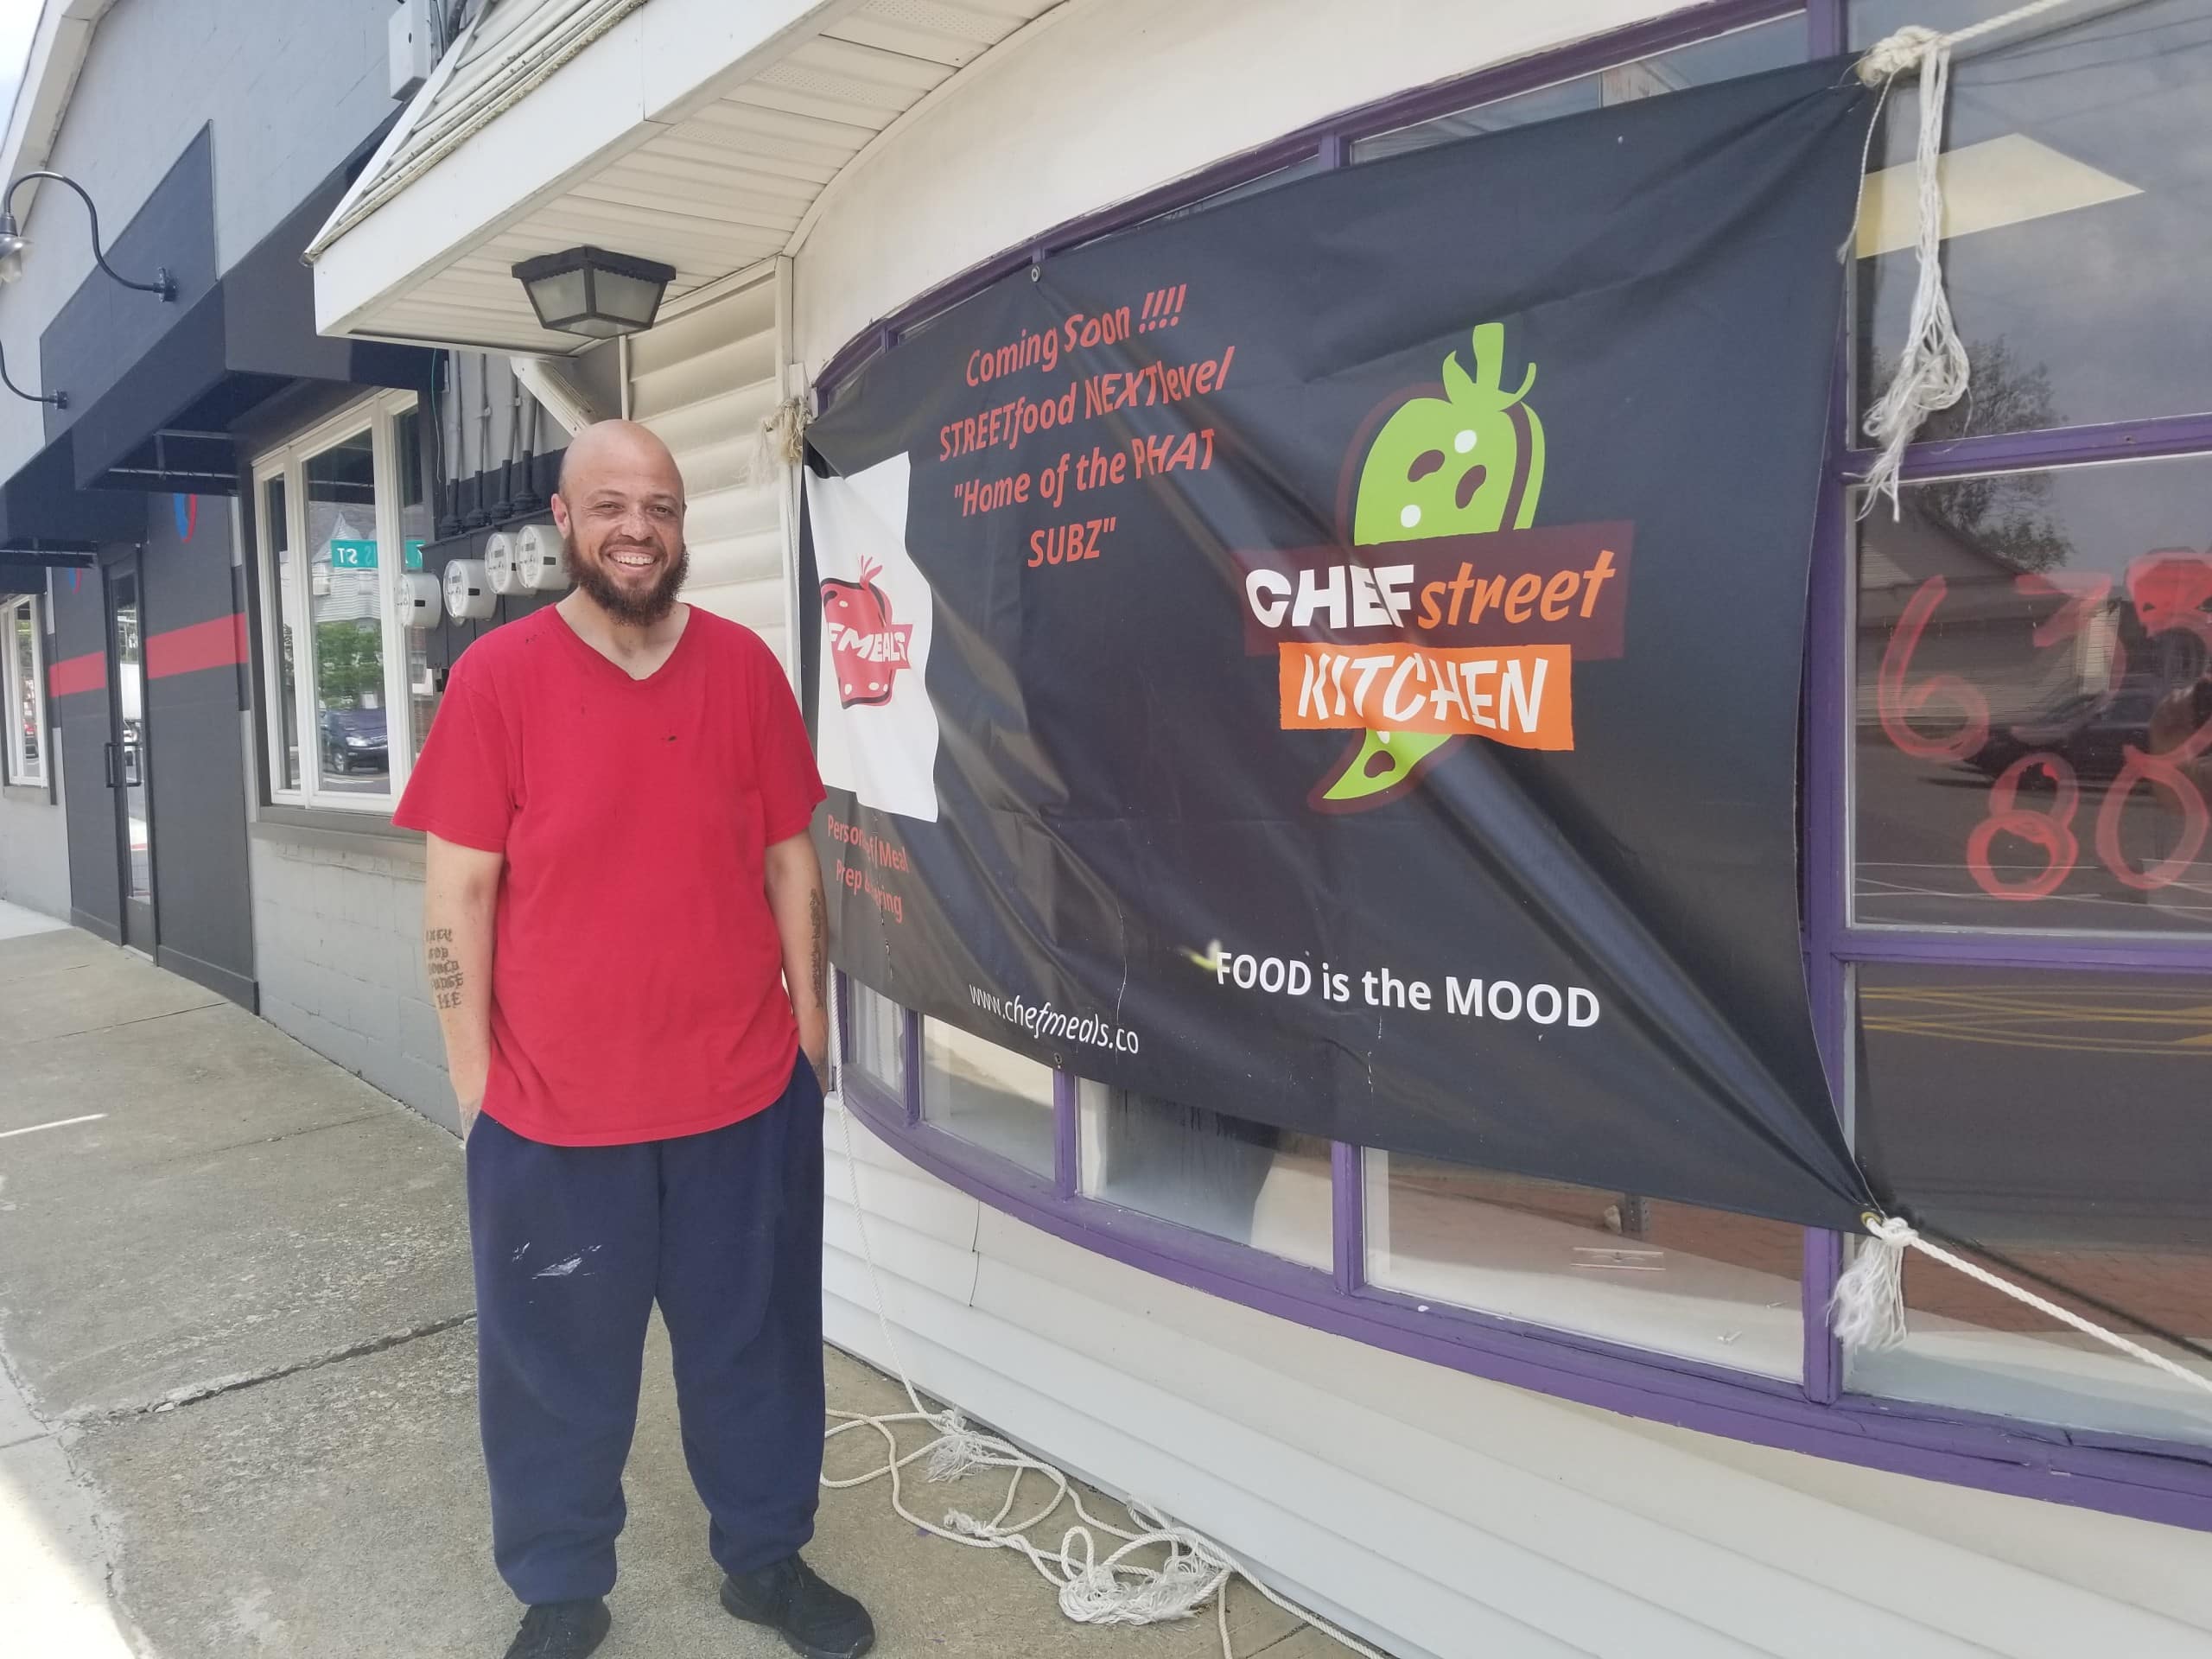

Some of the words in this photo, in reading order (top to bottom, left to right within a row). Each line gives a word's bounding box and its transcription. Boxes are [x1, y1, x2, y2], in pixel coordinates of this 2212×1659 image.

[966, 328, 1058, 387] Coming
[1064, 306, 1130, 353] Soon
[939, 381, 1077, 461] STREETfood
[954, 472, 1030, 517] "Home
[1039, 453, 1071, 507] of
[1077, 447, 1125, 492] the
[1133, 428, 1215, 480] PHAT
[1027, 517, 1116, 568] SUBZ"
[1245, 563, 1414, 629] CHEF
[1418, 550, 1616, 630] street
[1298, 652, 1548, 734] KITCHEN
[836, 859, 861, 895] Prep
[880, 841, 910, 872] Meal
[969, 983, 1139, 1054] www.chefmeals.co
[1217, 951, 1312, 995] FOOD
[1322, 963, 1350, 1002] is
[1361, 967, 1432, 1010] the
[1446, 976, 1601, 1027] MOOD
